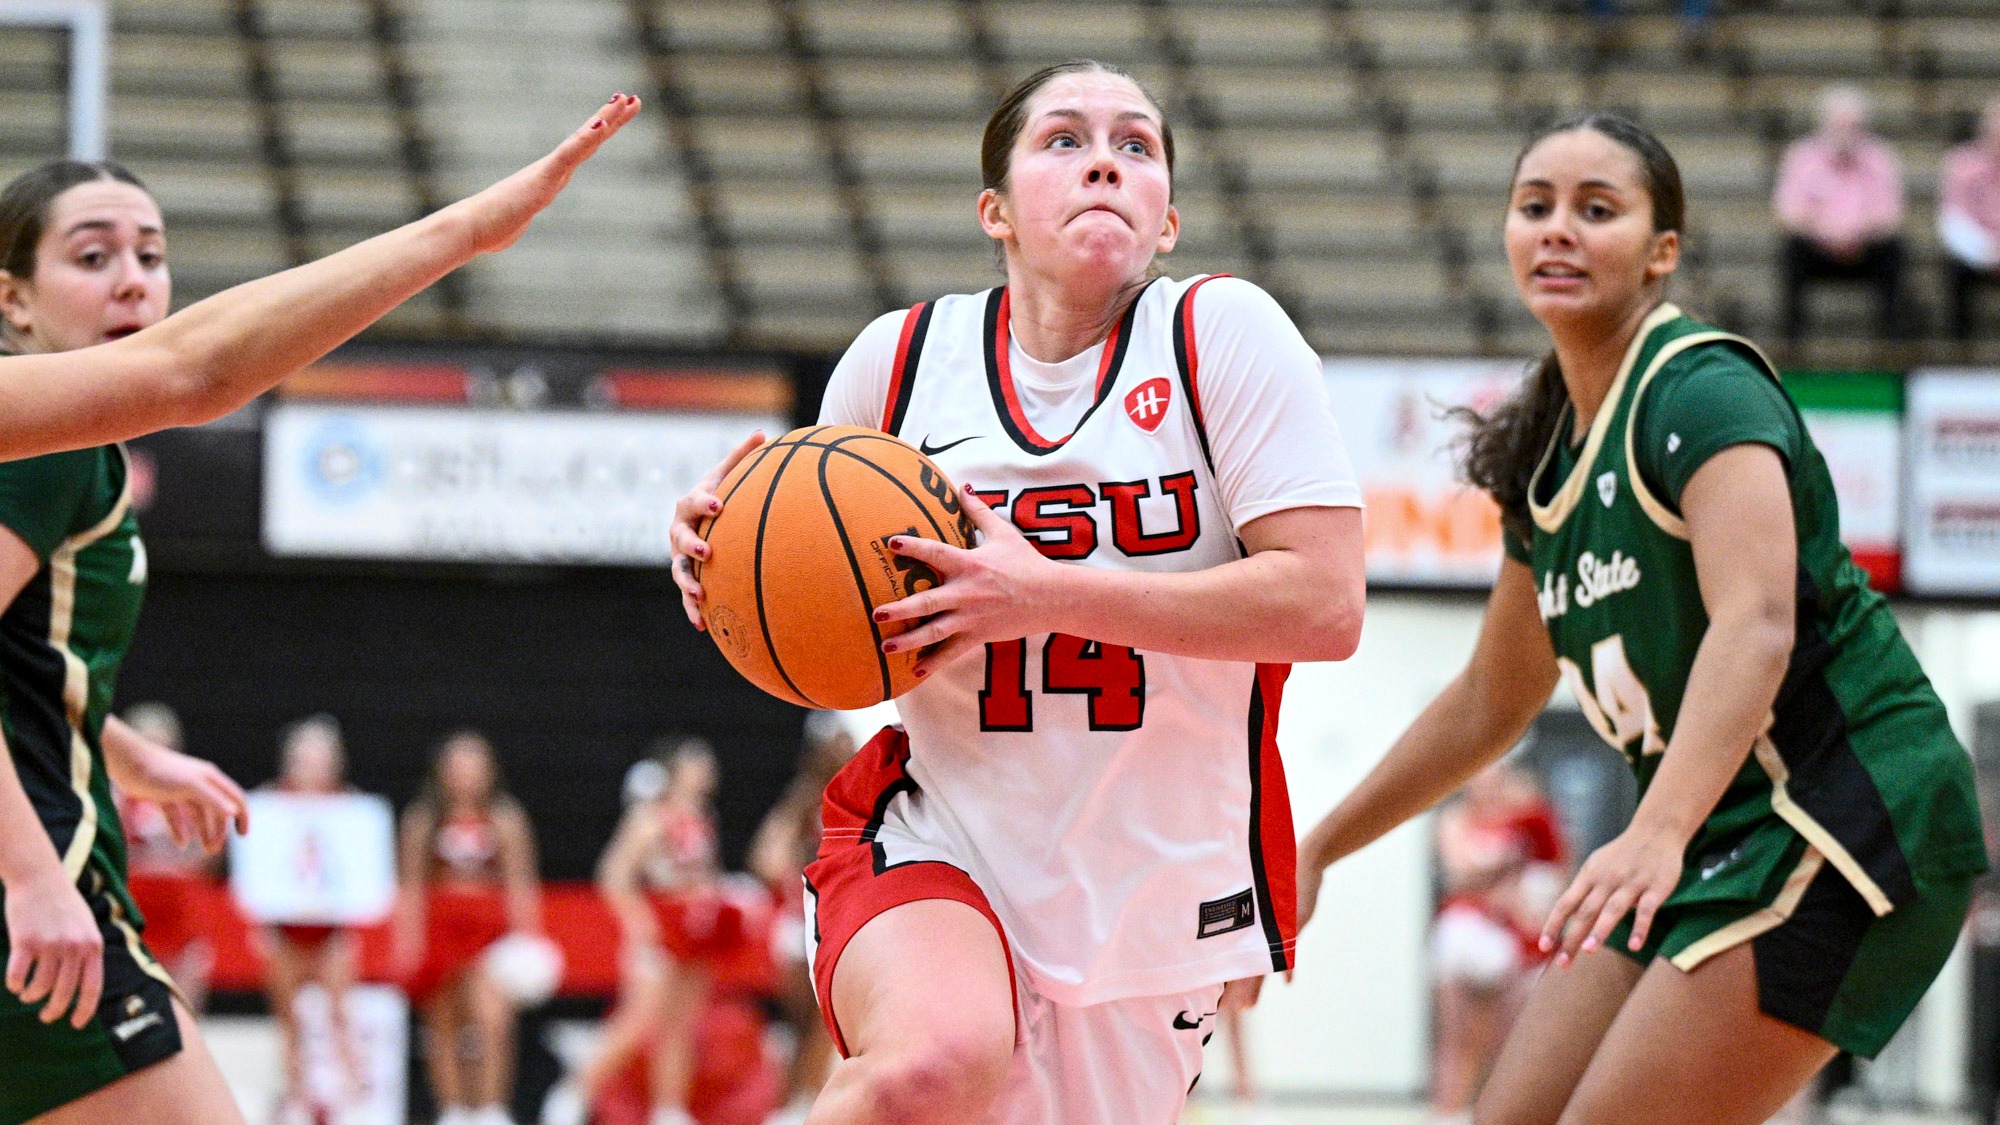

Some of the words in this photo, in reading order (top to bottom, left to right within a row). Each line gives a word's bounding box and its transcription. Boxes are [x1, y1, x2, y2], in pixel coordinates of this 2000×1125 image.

[870, 540, 902, 597] OFFICIAL
[1575, 549, 1641, 608] State
[978, 631, 1146, 732] 14
[1241, 901, 1250, 918] M
